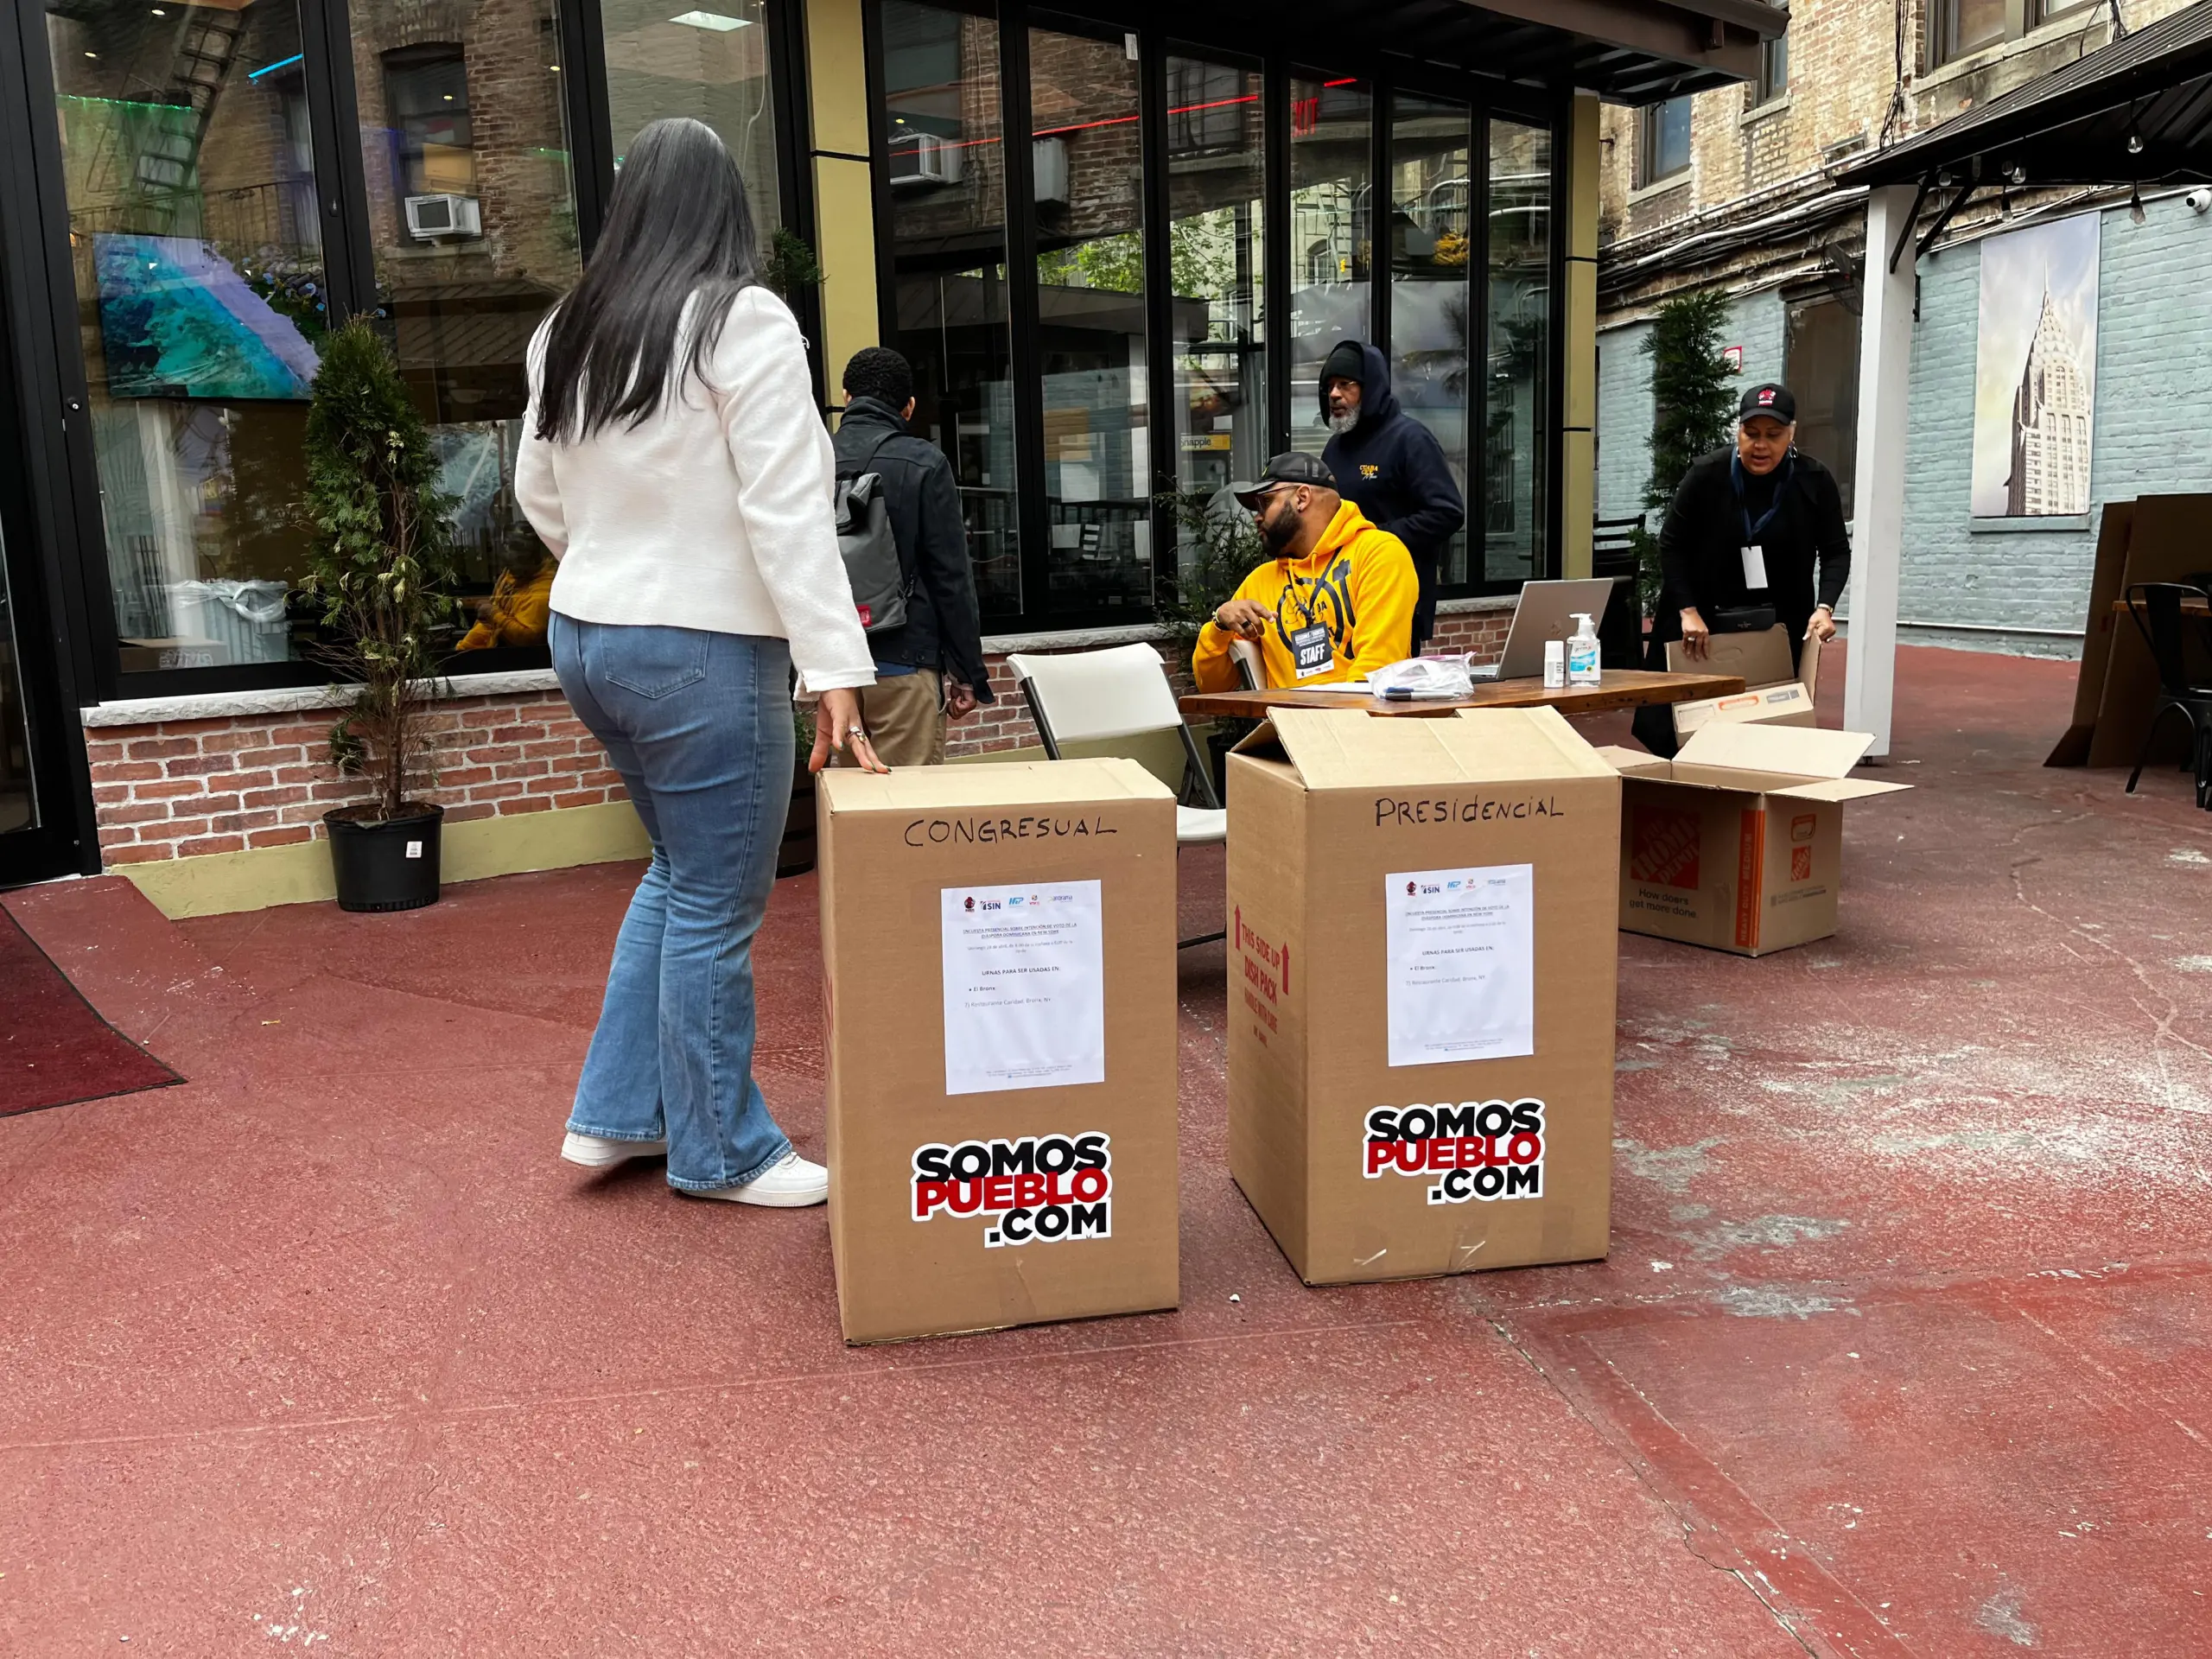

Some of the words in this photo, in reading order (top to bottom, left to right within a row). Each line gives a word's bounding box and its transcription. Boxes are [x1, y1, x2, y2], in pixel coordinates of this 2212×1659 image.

[1291, 97, 1318, 137] XIT
[1180, 436, 1211, 448] Snapple
[1300, 643, 1325, 666] STAFF
[904, 817, 1117, 847] CONGRESUAL
[1742, 833, 1752, 880] MEDIUM
[1630, 899, 1644, 910] get
[1646, 902, 1671, 914] more
[1638, 887, 1660, 900] How
[1662, 893, 1689, 906] doers
[1741, 887, 1751, 908] DUTY
[1242, 923, 1255, 950] THIS
[1255, 936, 1269, 963] SIDE
[1271, 948, 1281, 970] UP
[1245, 954, 1258, 988] DISH
[1261, 969, 1277, 1006] PACK
[1368, 1103, 1541, 1144] SOMOS
[916, 1136, 1107, 1183] SOMOS
[1368, 1132, 1541, 1173] PUEBLO
[917, 1167, 1108, 1217] PUEBLO
[1432, 1165, 1539, 1200] .COM
[989, 1203, 1107, 1243] .COM
